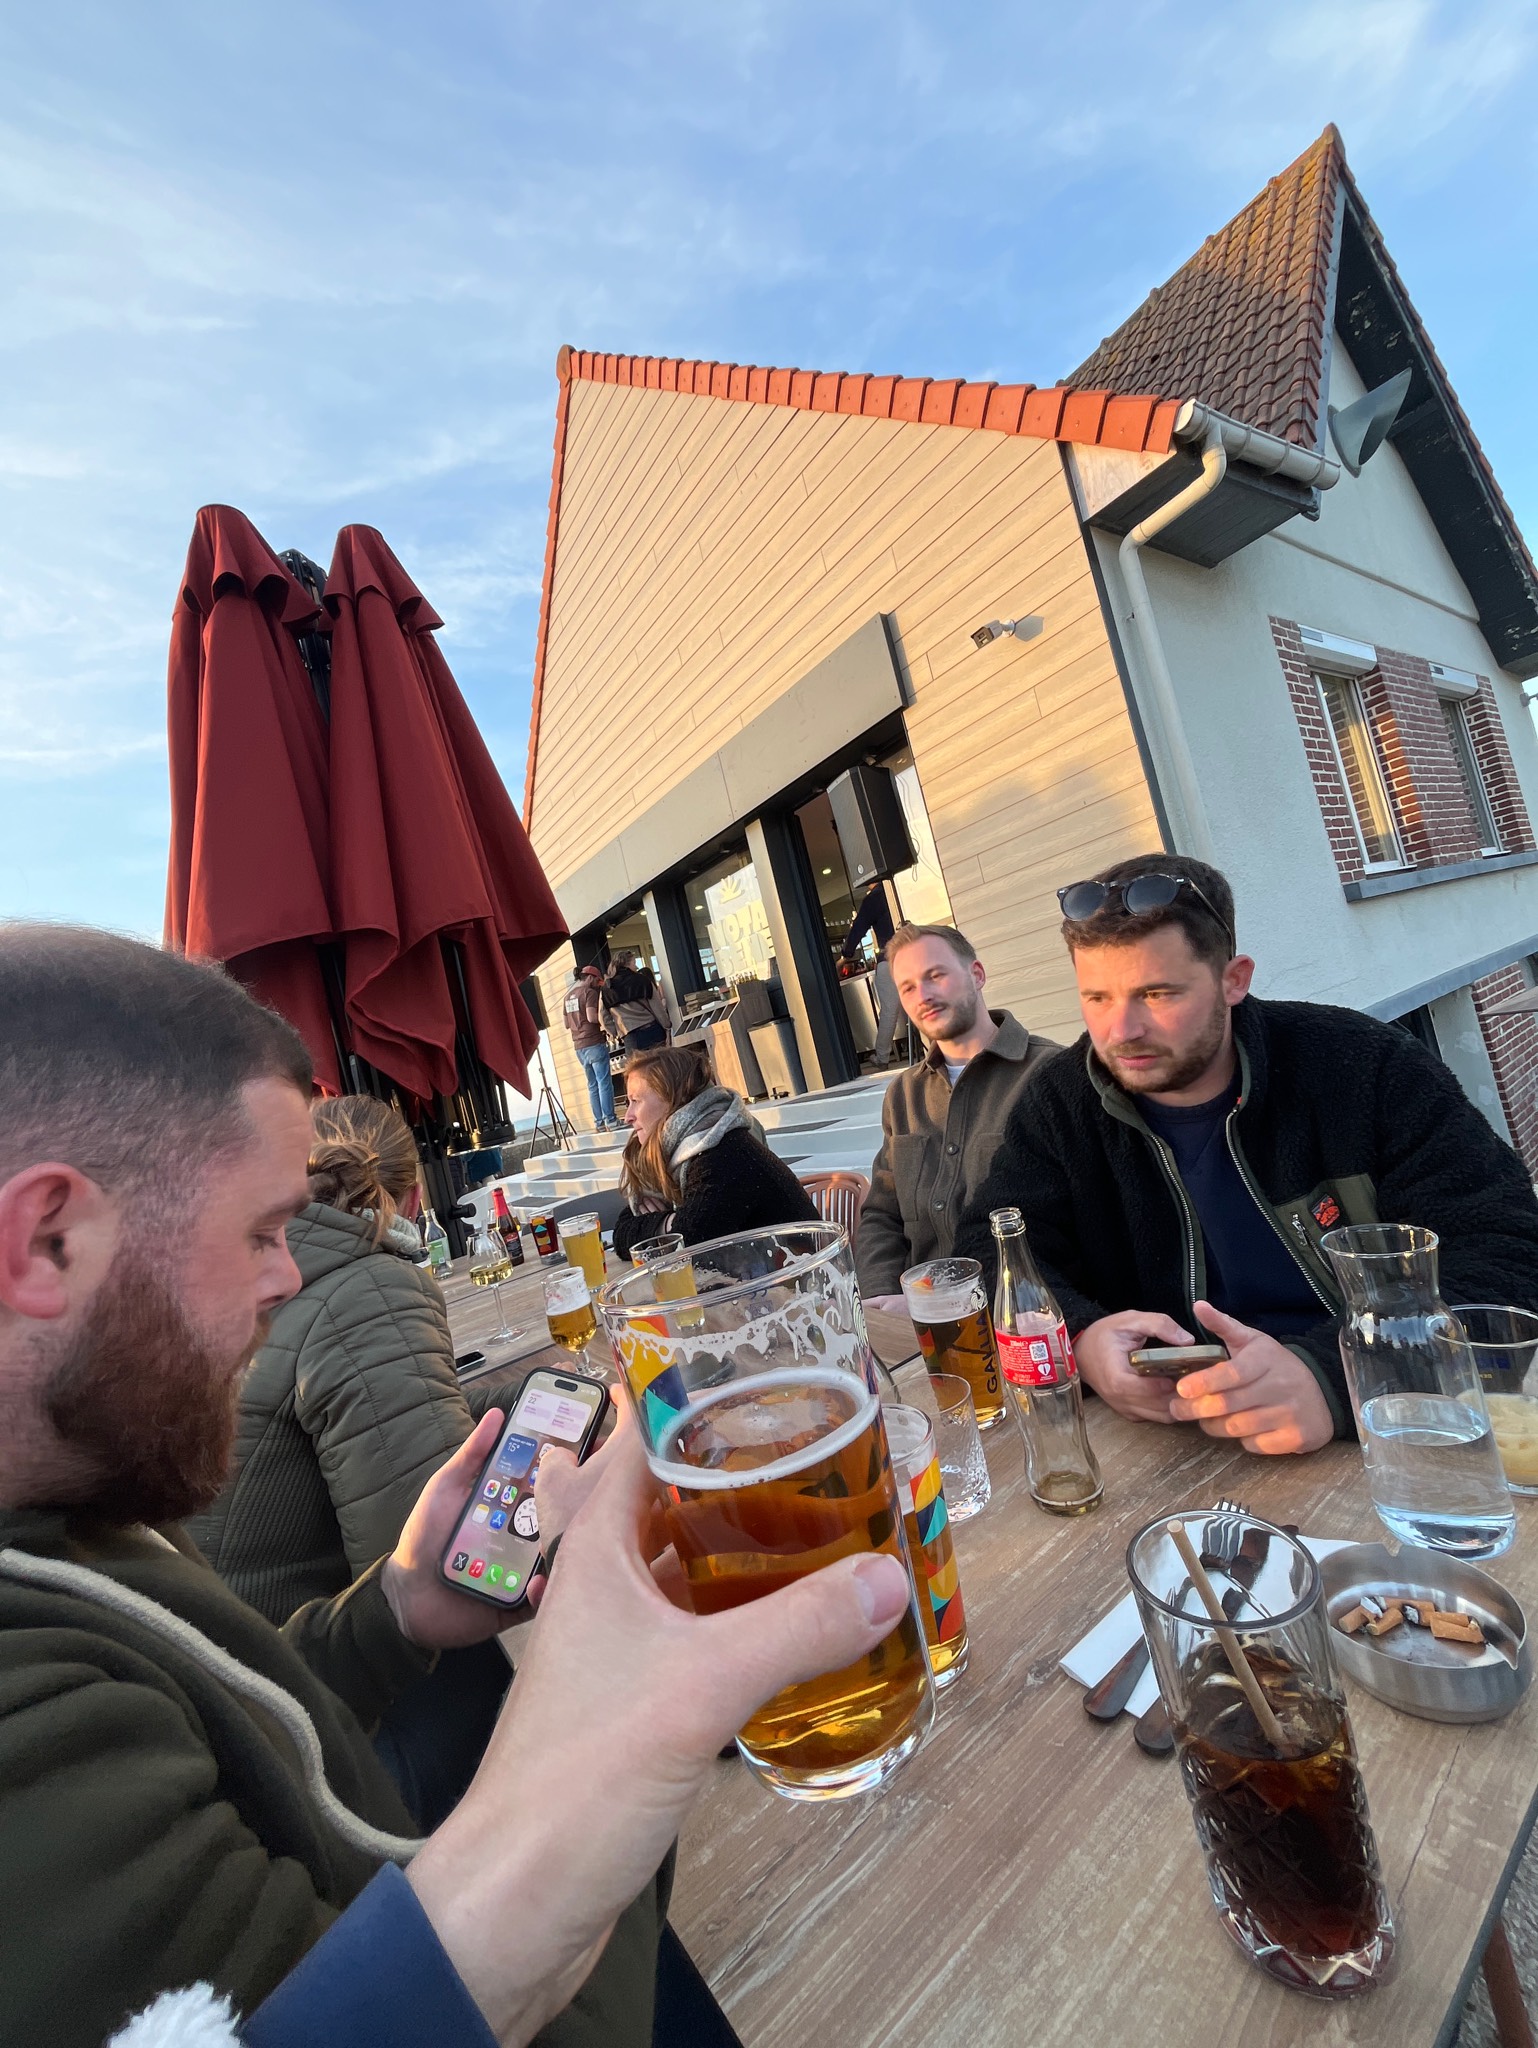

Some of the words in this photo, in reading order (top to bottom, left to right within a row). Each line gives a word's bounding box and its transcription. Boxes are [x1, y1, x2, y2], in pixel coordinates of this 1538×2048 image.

[706, 899, 769, 951] NOTA
[975, 1311, 998, 1394] GALLIA
[528, 1396, 537, 1405] 22
